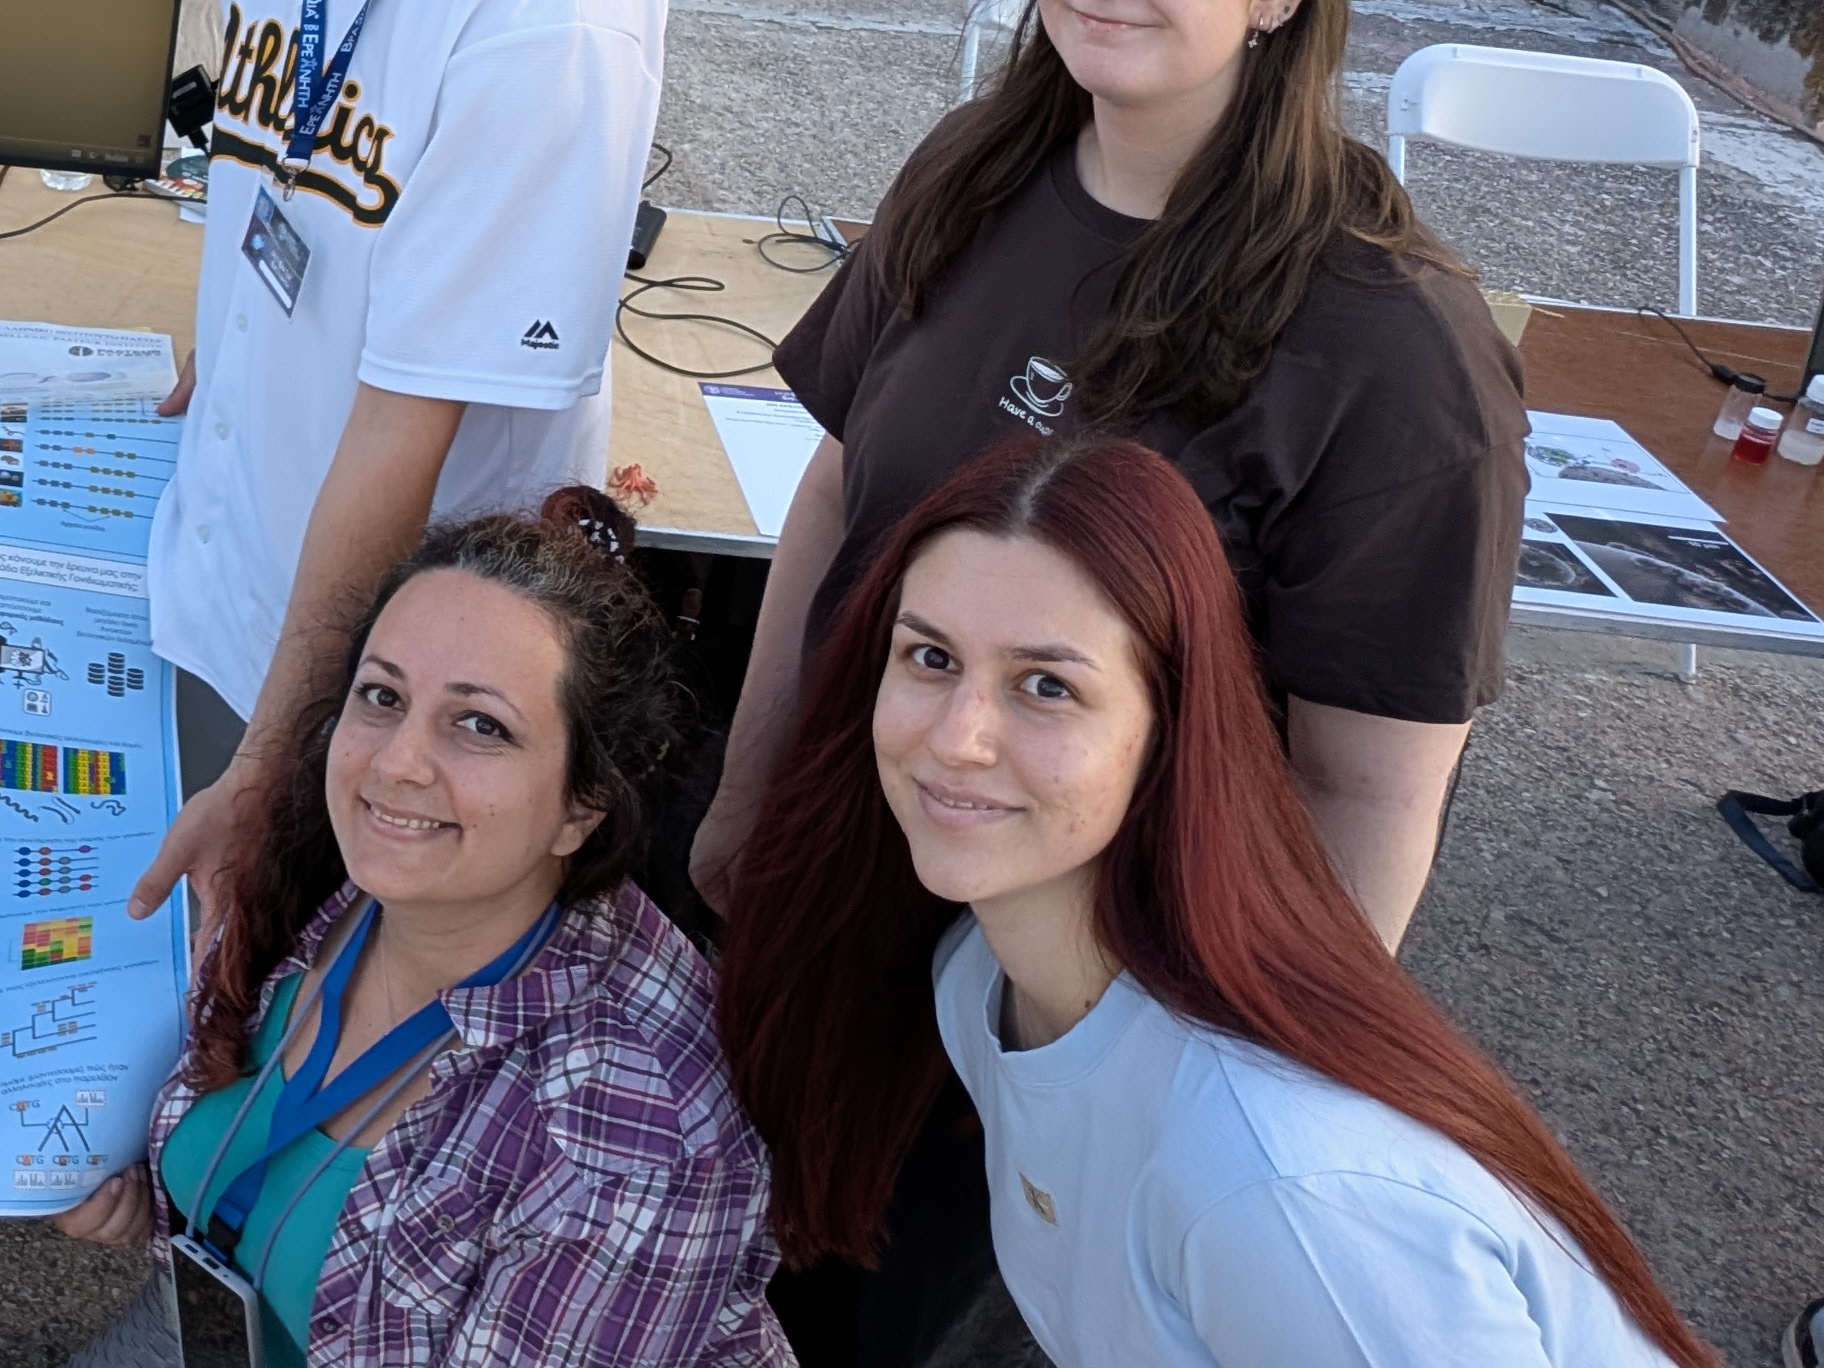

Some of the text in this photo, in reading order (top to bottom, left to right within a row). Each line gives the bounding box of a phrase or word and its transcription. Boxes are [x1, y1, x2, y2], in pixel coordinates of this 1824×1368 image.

[998, 396, 1026, 419] Have
[1027, 416, 1034, 426] a
[8, 552, 48, 568] κάνουμε
[50, 560, 66, 570] την
[66, 562, 98, 575] έρευνα
[100, 568, 118, 579] μας
[120, 571, 142, 581] στην
[20, 565, 68, 582] Εξελικτικής
